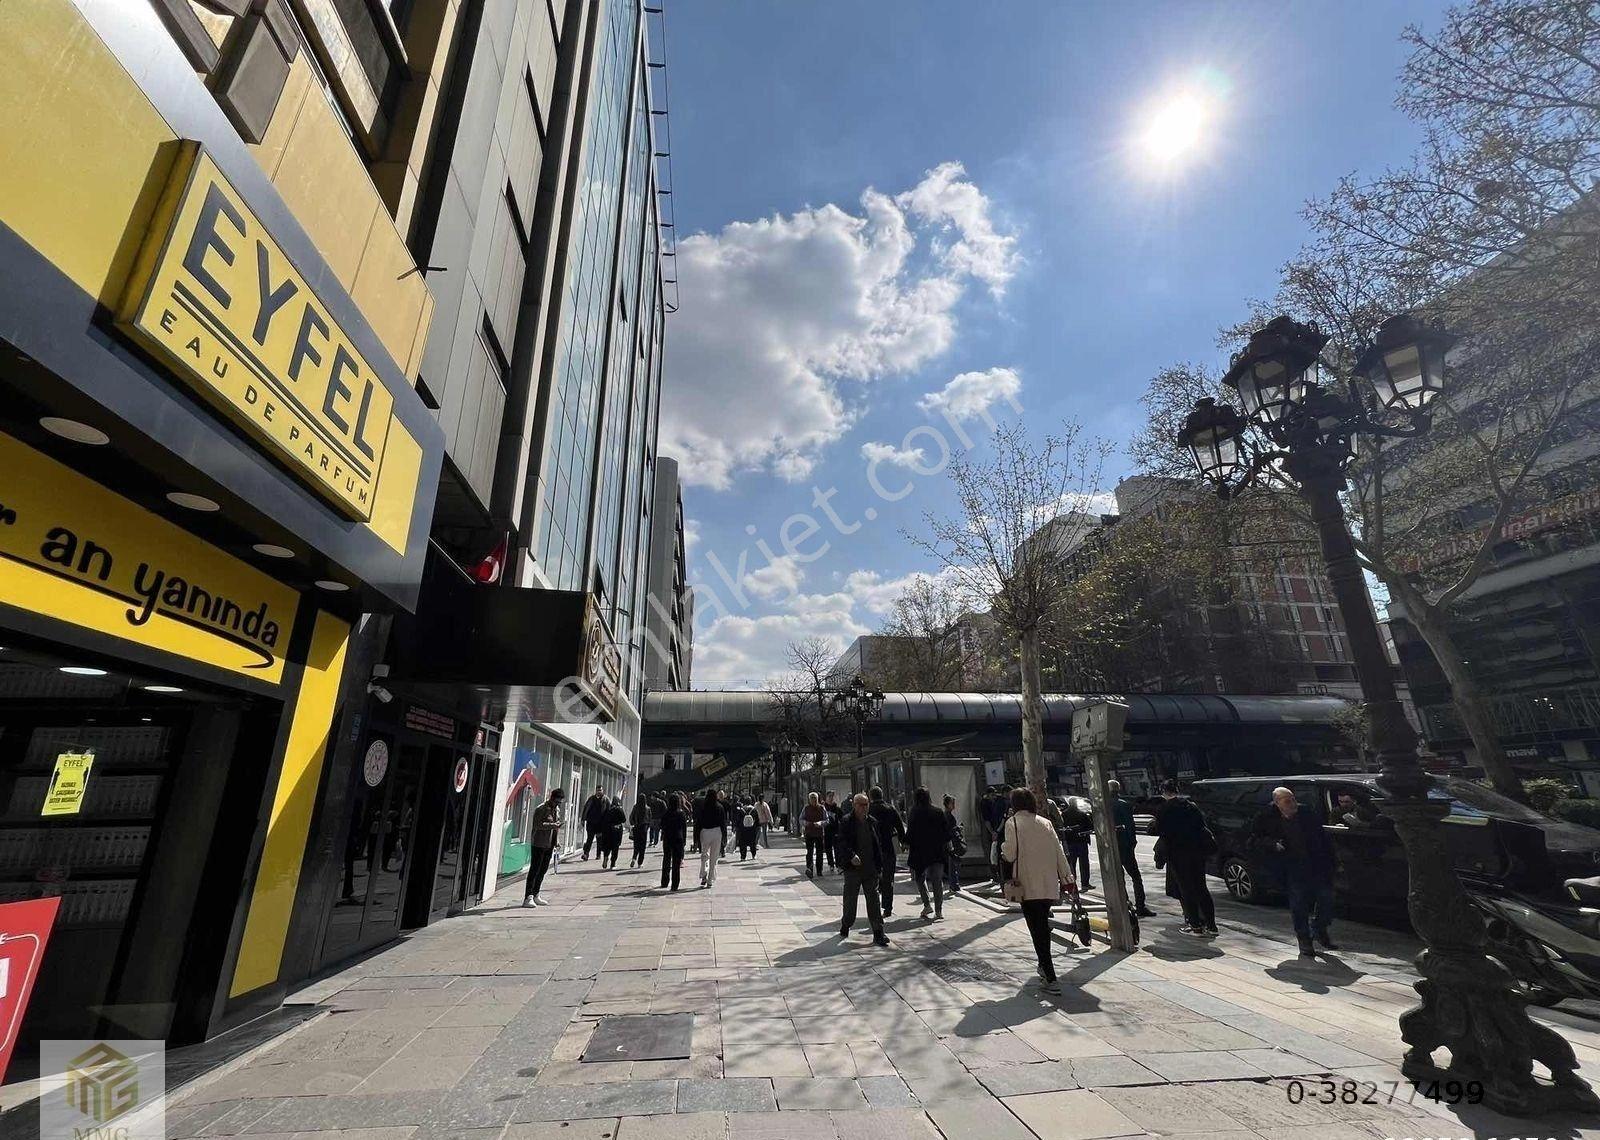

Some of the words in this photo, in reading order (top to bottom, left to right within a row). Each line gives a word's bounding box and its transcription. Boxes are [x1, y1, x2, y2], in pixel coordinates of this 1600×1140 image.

[182, 180, 375, 462] EYFEL
[160, 308, 229, 379] EAU
[244, 384, 282, 423] DE
[289, 424, 367, 505] PARFUM
[39, 527, 113, 581] an
[125, 562, 280, 648] yanında
[63, 758, 85, 768] EYFEL
[1505, 746, 1538, 757] mavi
